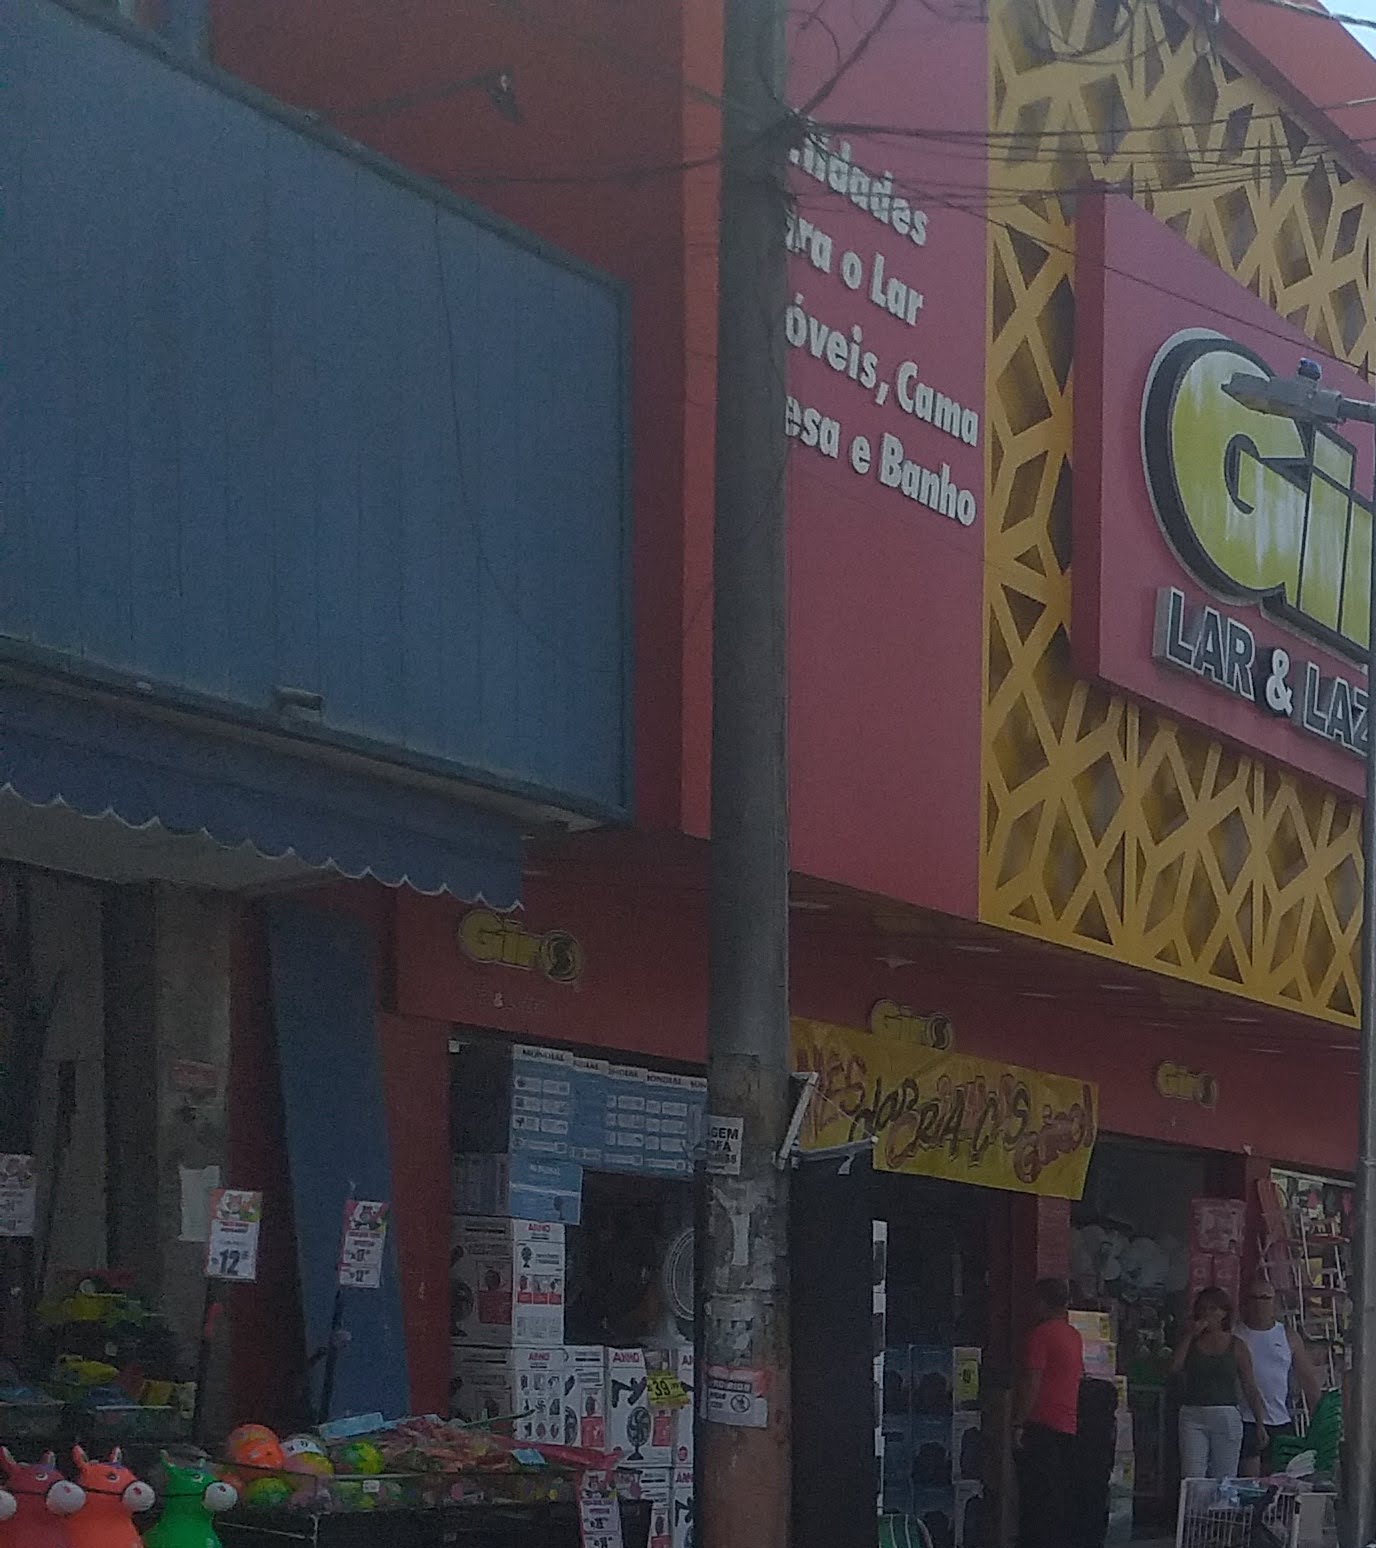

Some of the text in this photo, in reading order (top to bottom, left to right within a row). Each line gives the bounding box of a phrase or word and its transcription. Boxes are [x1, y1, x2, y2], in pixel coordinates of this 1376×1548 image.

[841, 251, 862, 290] o
[871, 252, 924, 326] Lar
[786, 293, 979, 447] óveis, Cama
[785, 396, 977, 527] esa e Banho
[1163, 588, 1257, 702] LAR
[1265, 648, 1293, 717] &
[711, 1126, 739, 1139] GEM
